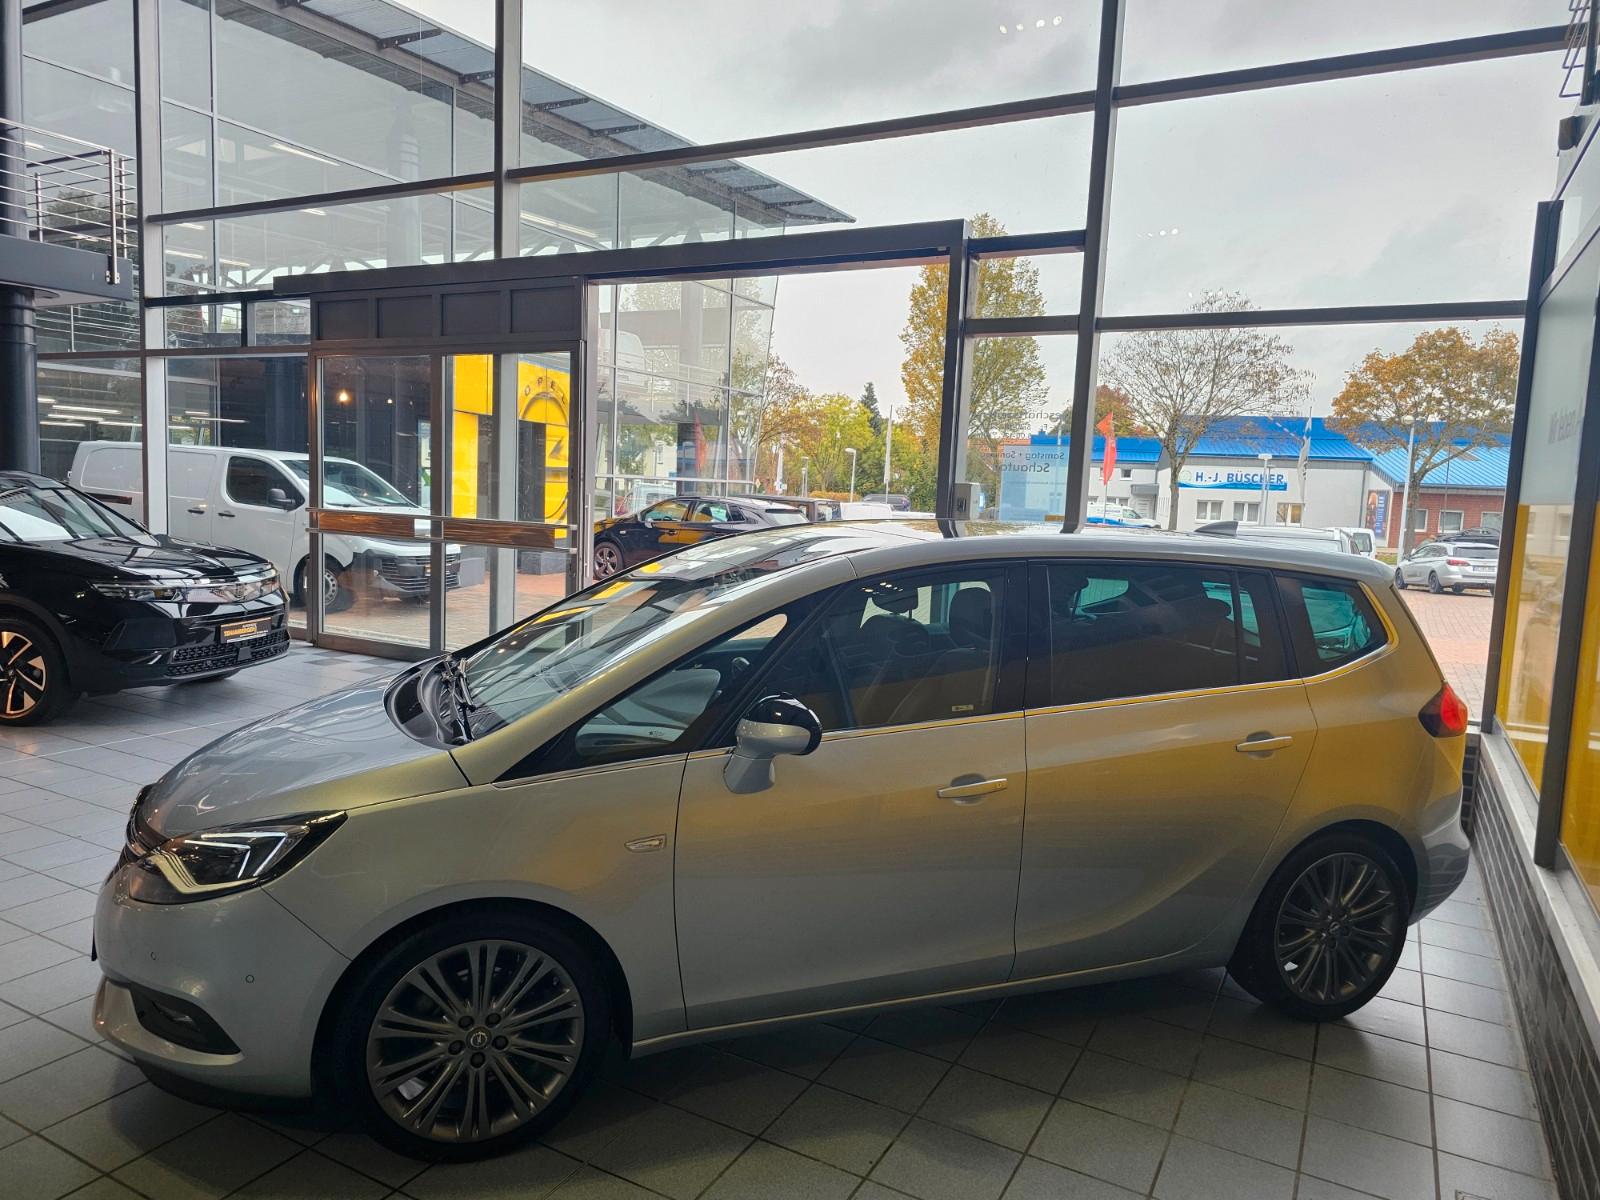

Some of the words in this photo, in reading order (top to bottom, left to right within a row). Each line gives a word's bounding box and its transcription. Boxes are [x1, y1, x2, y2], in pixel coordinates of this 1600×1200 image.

[524, 377, 566, 405] OPEL
[1195, 471, 1222, 483] H.-J.
[1226, 469, 1285, 484] BÜSCHER
